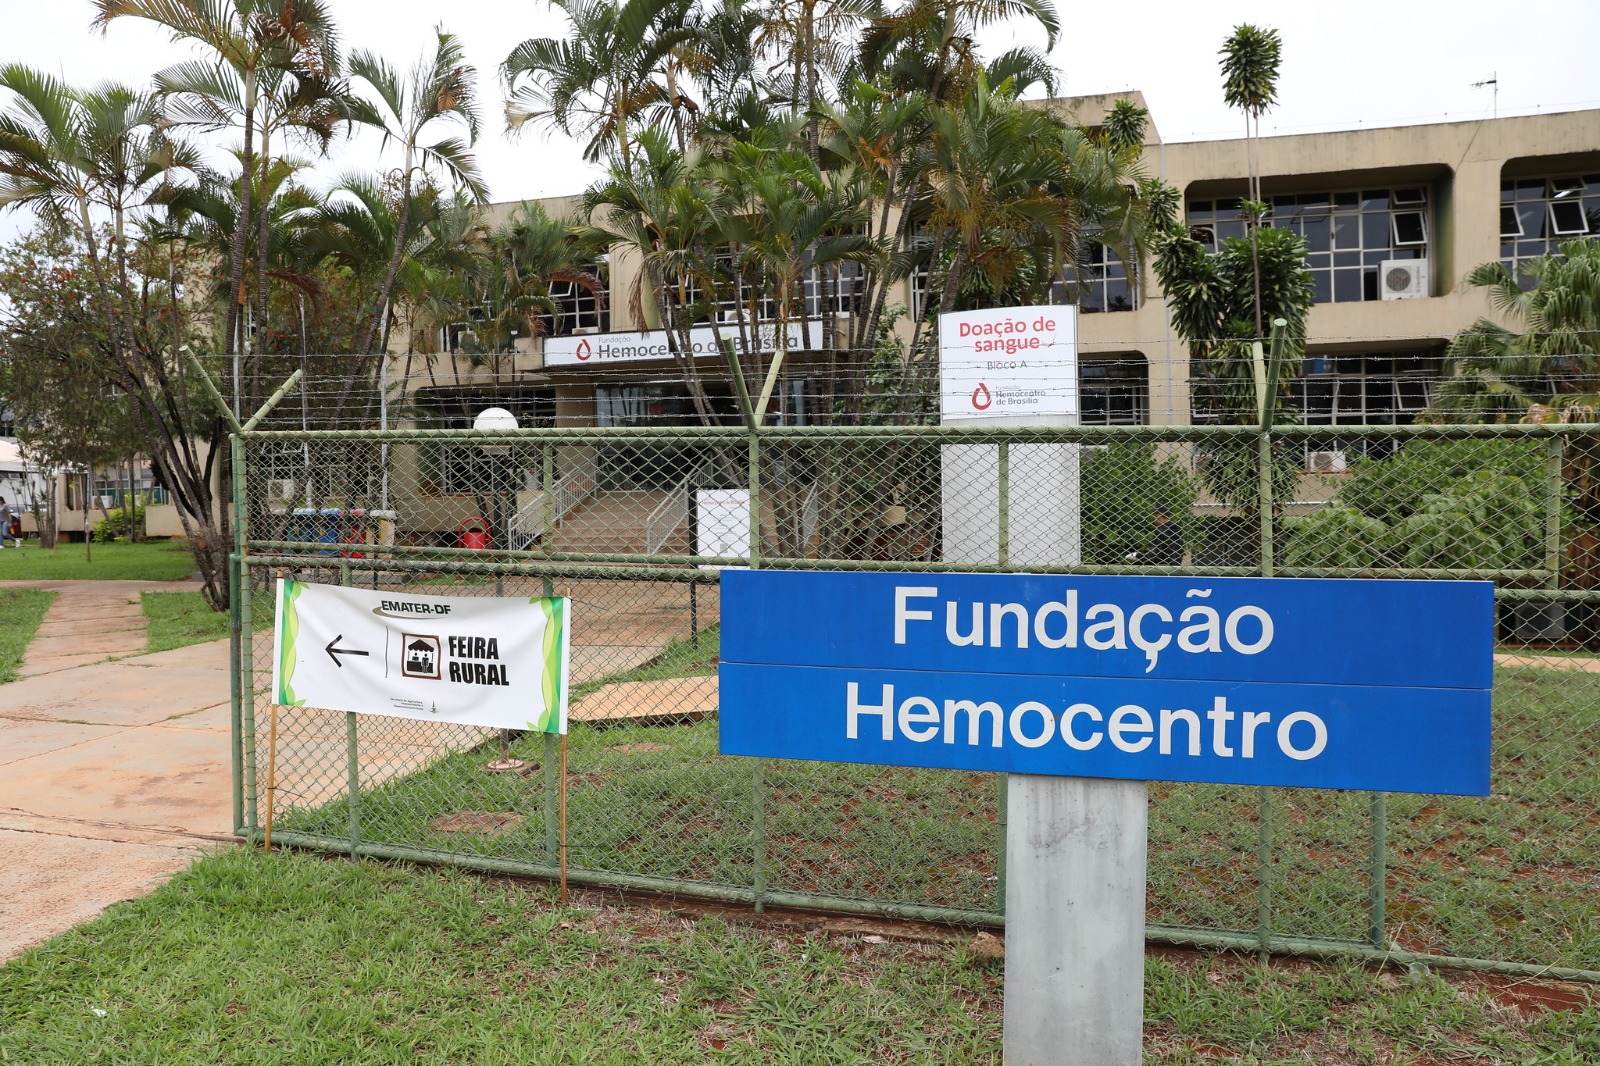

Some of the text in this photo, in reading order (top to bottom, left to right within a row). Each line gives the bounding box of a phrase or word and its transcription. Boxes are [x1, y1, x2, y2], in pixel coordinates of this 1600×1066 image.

[959, 316, 1056, 338] Doação de
[598, 336, 631, 345] Fundação
[598, 340, 703, 359] Hemoceo
[975, 337, 1040, 355] sangue
[987, 360, 1028, 370] Bloco A
[995, 390, 1046, 398] Hemocentro
[381, 600, 451, 615] EMATER-DF
[895, 586, 1274, 673] Fundação
[448, 635, 499, 660] FEIRA
[448, 661, 510, 686] RURAL
[845, 681, 1328, 761] Hemocentro
